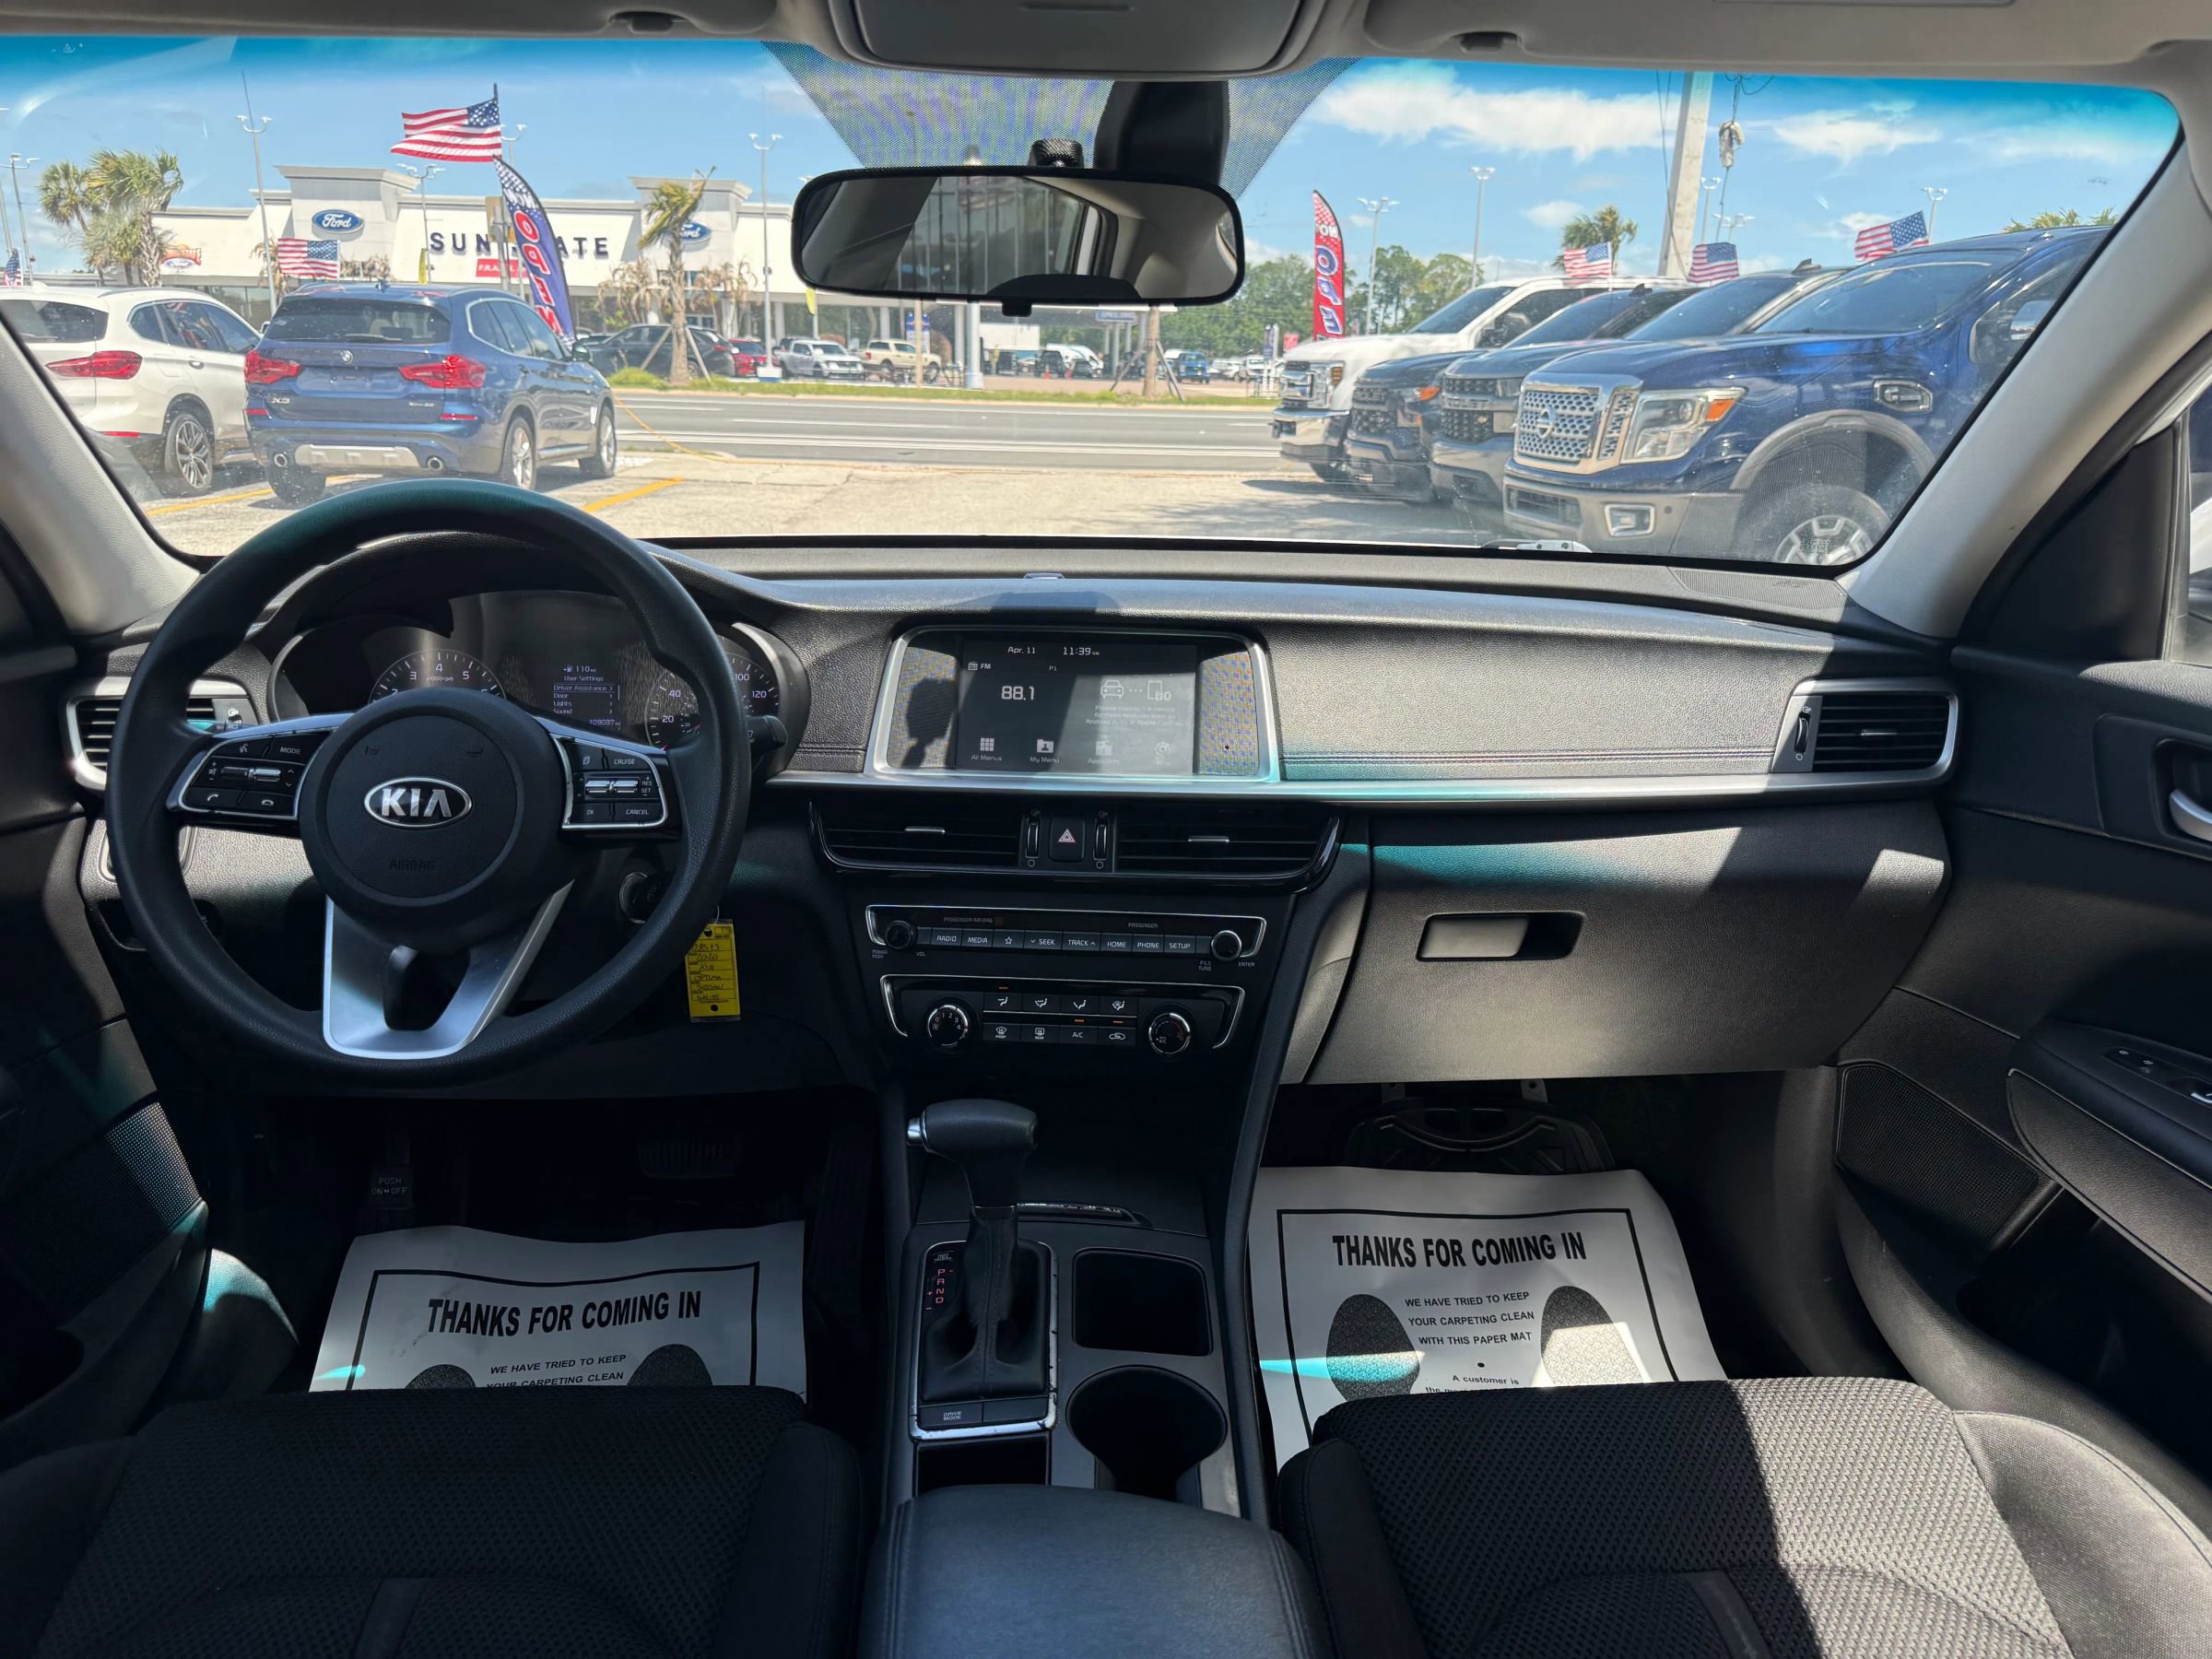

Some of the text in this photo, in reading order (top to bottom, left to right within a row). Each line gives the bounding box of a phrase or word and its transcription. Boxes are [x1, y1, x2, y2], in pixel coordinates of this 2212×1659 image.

[322, 213, 352, 228] Ford
[1007, 646, 1036, 654] Apr. 11
[1063, 646, 1091, 655] 11:39
[435, 663, 442, 673] 4
[409, 671, 417, 680] 3
[462, 671, 470, 680] 5
[669, 689, 681, 698] 40
[752, 690, 767, 699] 120
[1001, 685, 1035, 700] 88.1
[662, 715, 675, 724] 20
[279, 746, 301, 755] MODE
[381, 787, 453, 818] KIA
[936, 935, 957, 943] RADIO
[967, 935, 988, 944] MEDIA
[1038, 937, 1055, 946] SEEK
[1067, 938, 1088, 947] TRACK
[1168, 942, 1191, 950] SETUP
[378, 1176, 402, 1185] PUSH
[1332, 1231, 1587, 1267] THANKS FOR COMING IN
[937, 1268, 946, 1277] P
[1405, 1291, 1530, 1307] WE HAVE TRIED TO KEEP
[428, 1290, 701, 1337] THANKS FOR COMING IN
[1408, 1311, 1535, 1326] YOUR CARPETING CLEAN
[1418, 1331, 1533, 1346] WITH THIS PAPER MAT
[490, 1354, 627, 1374] WE HAVE TRIED TO KEEP
[522, 1375, 583, 1387] CARPETING
[587, 1371, 624, 1382] CLEAN
[1463, 1376, 1508, 1384] customer
